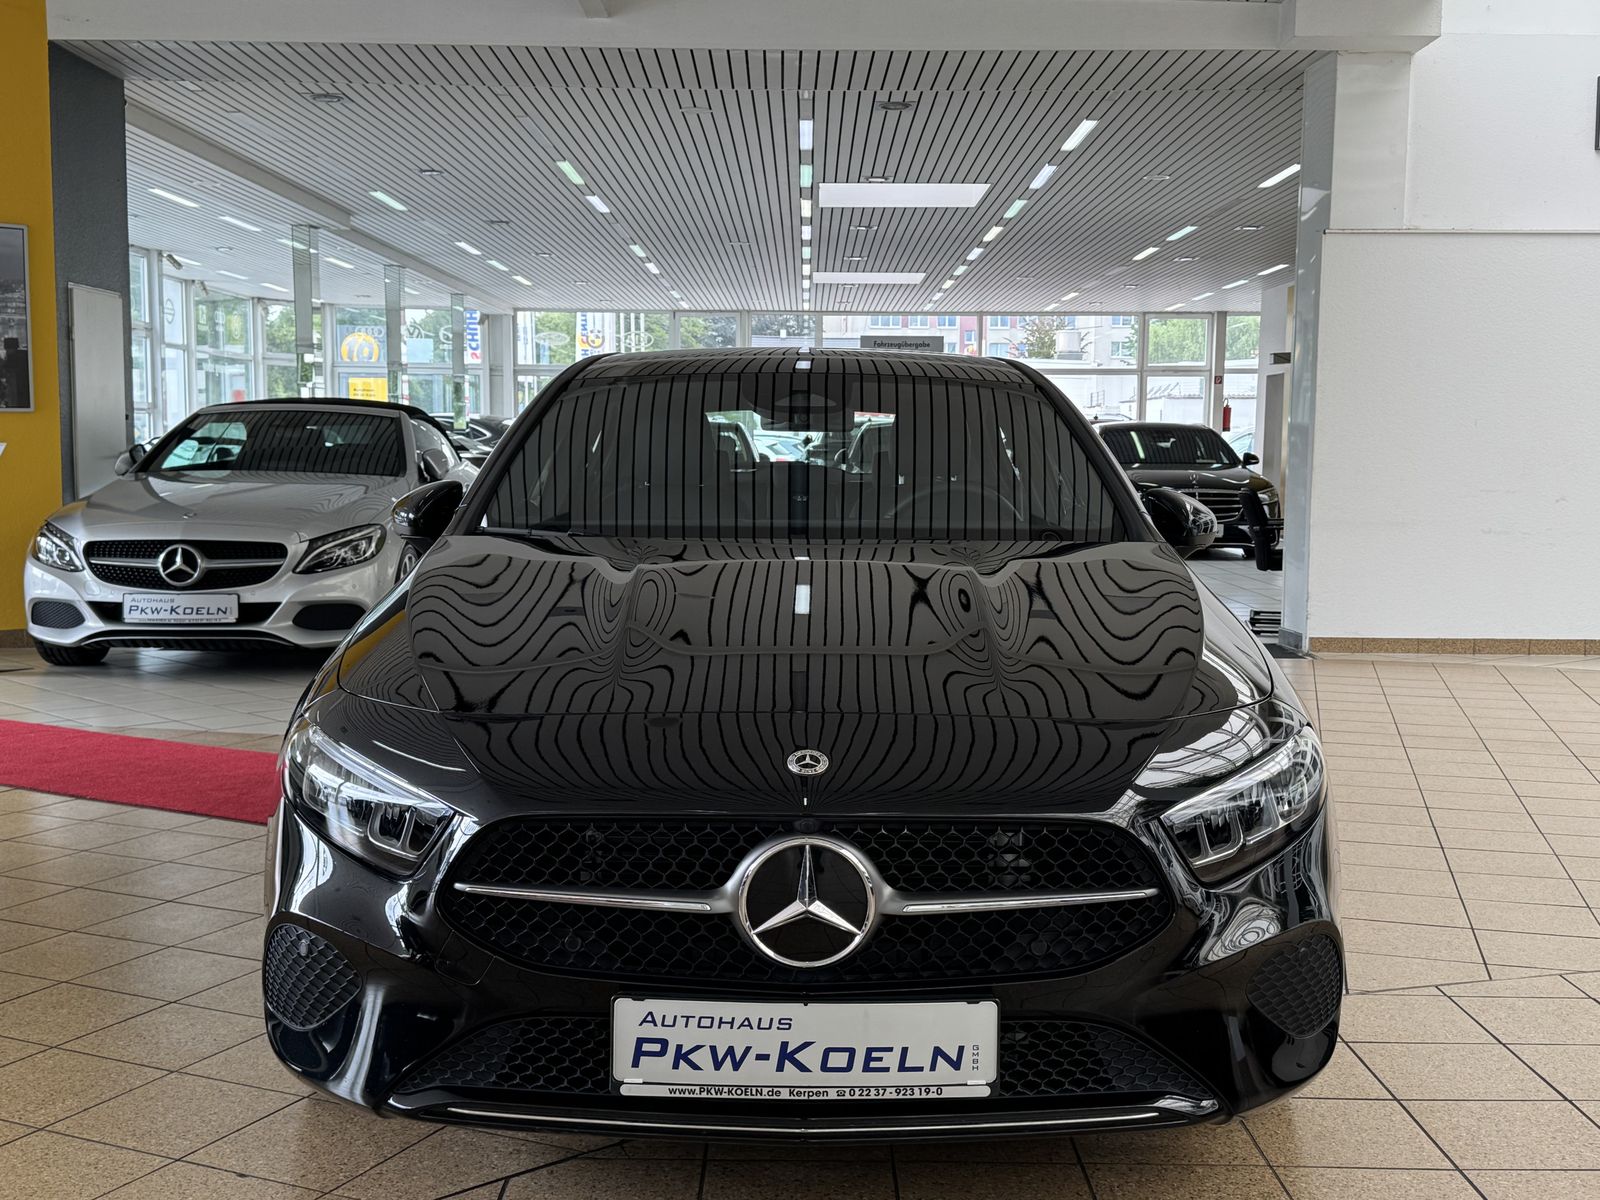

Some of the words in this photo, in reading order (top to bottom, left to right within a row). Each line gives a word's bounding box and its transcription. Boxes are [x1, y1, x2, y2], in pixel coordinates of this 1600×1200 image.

[873, 340, 931, 349] Fahrzeugübergabe
[638, 1011, 793, 1031] AUTOHAUS
[631, 1037, 965, 1073] PKW-KOELN
[668, 1086, 782, 1097] www.PKW-KOELN.de
[788, 1088, 829, 1099] Kerpen
